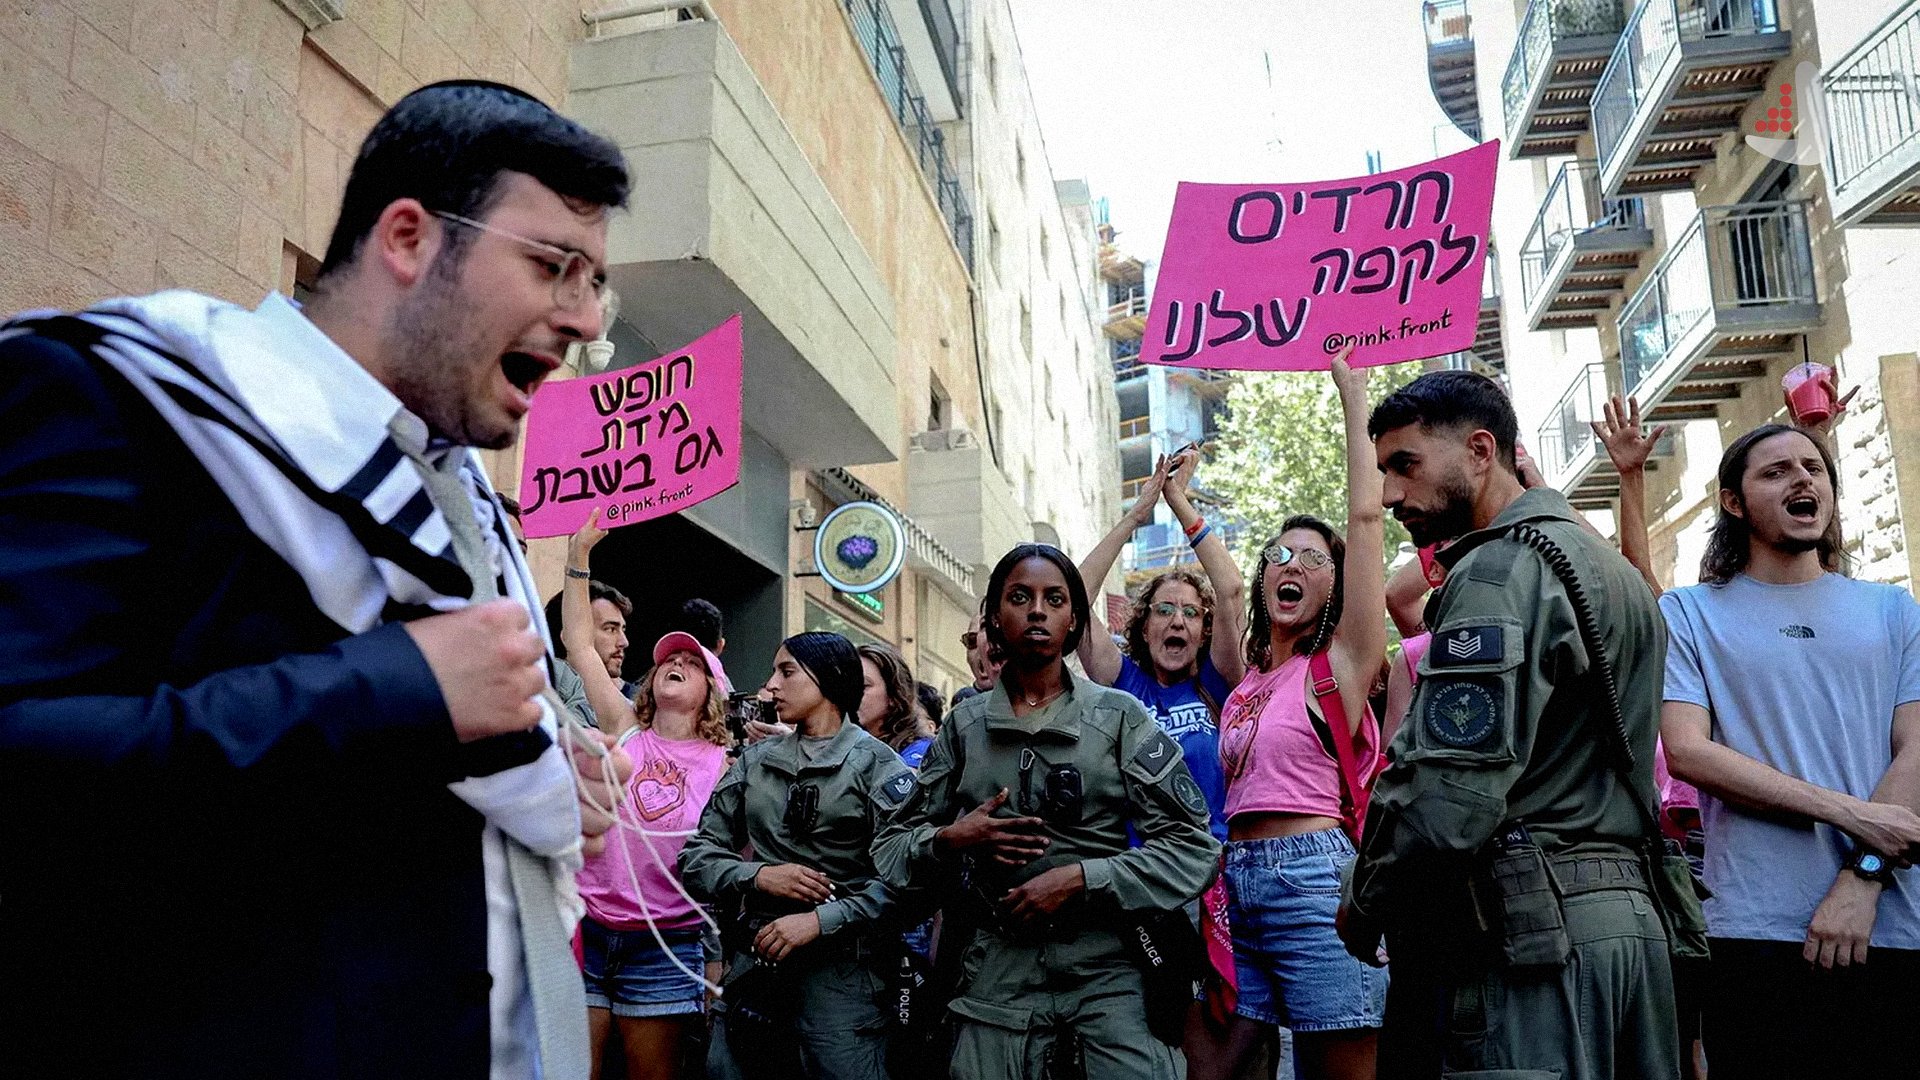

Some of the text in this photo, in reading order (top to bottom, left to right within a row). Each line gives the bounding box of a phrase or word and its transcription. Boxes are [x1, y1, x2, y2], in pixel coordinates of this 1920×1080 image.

[1228, 171, 1454, 244] חרדים
[1310, 224, 1479, 304] לקפה
[1159, 289, 1311, 361] שלנו
[590, 354, 695, 416] חופש
[522, 426, 723, 515] גם בשבת
[606, 483, 694, 521] @pink.front
[1136, 925, 1163, 967] POLICE
